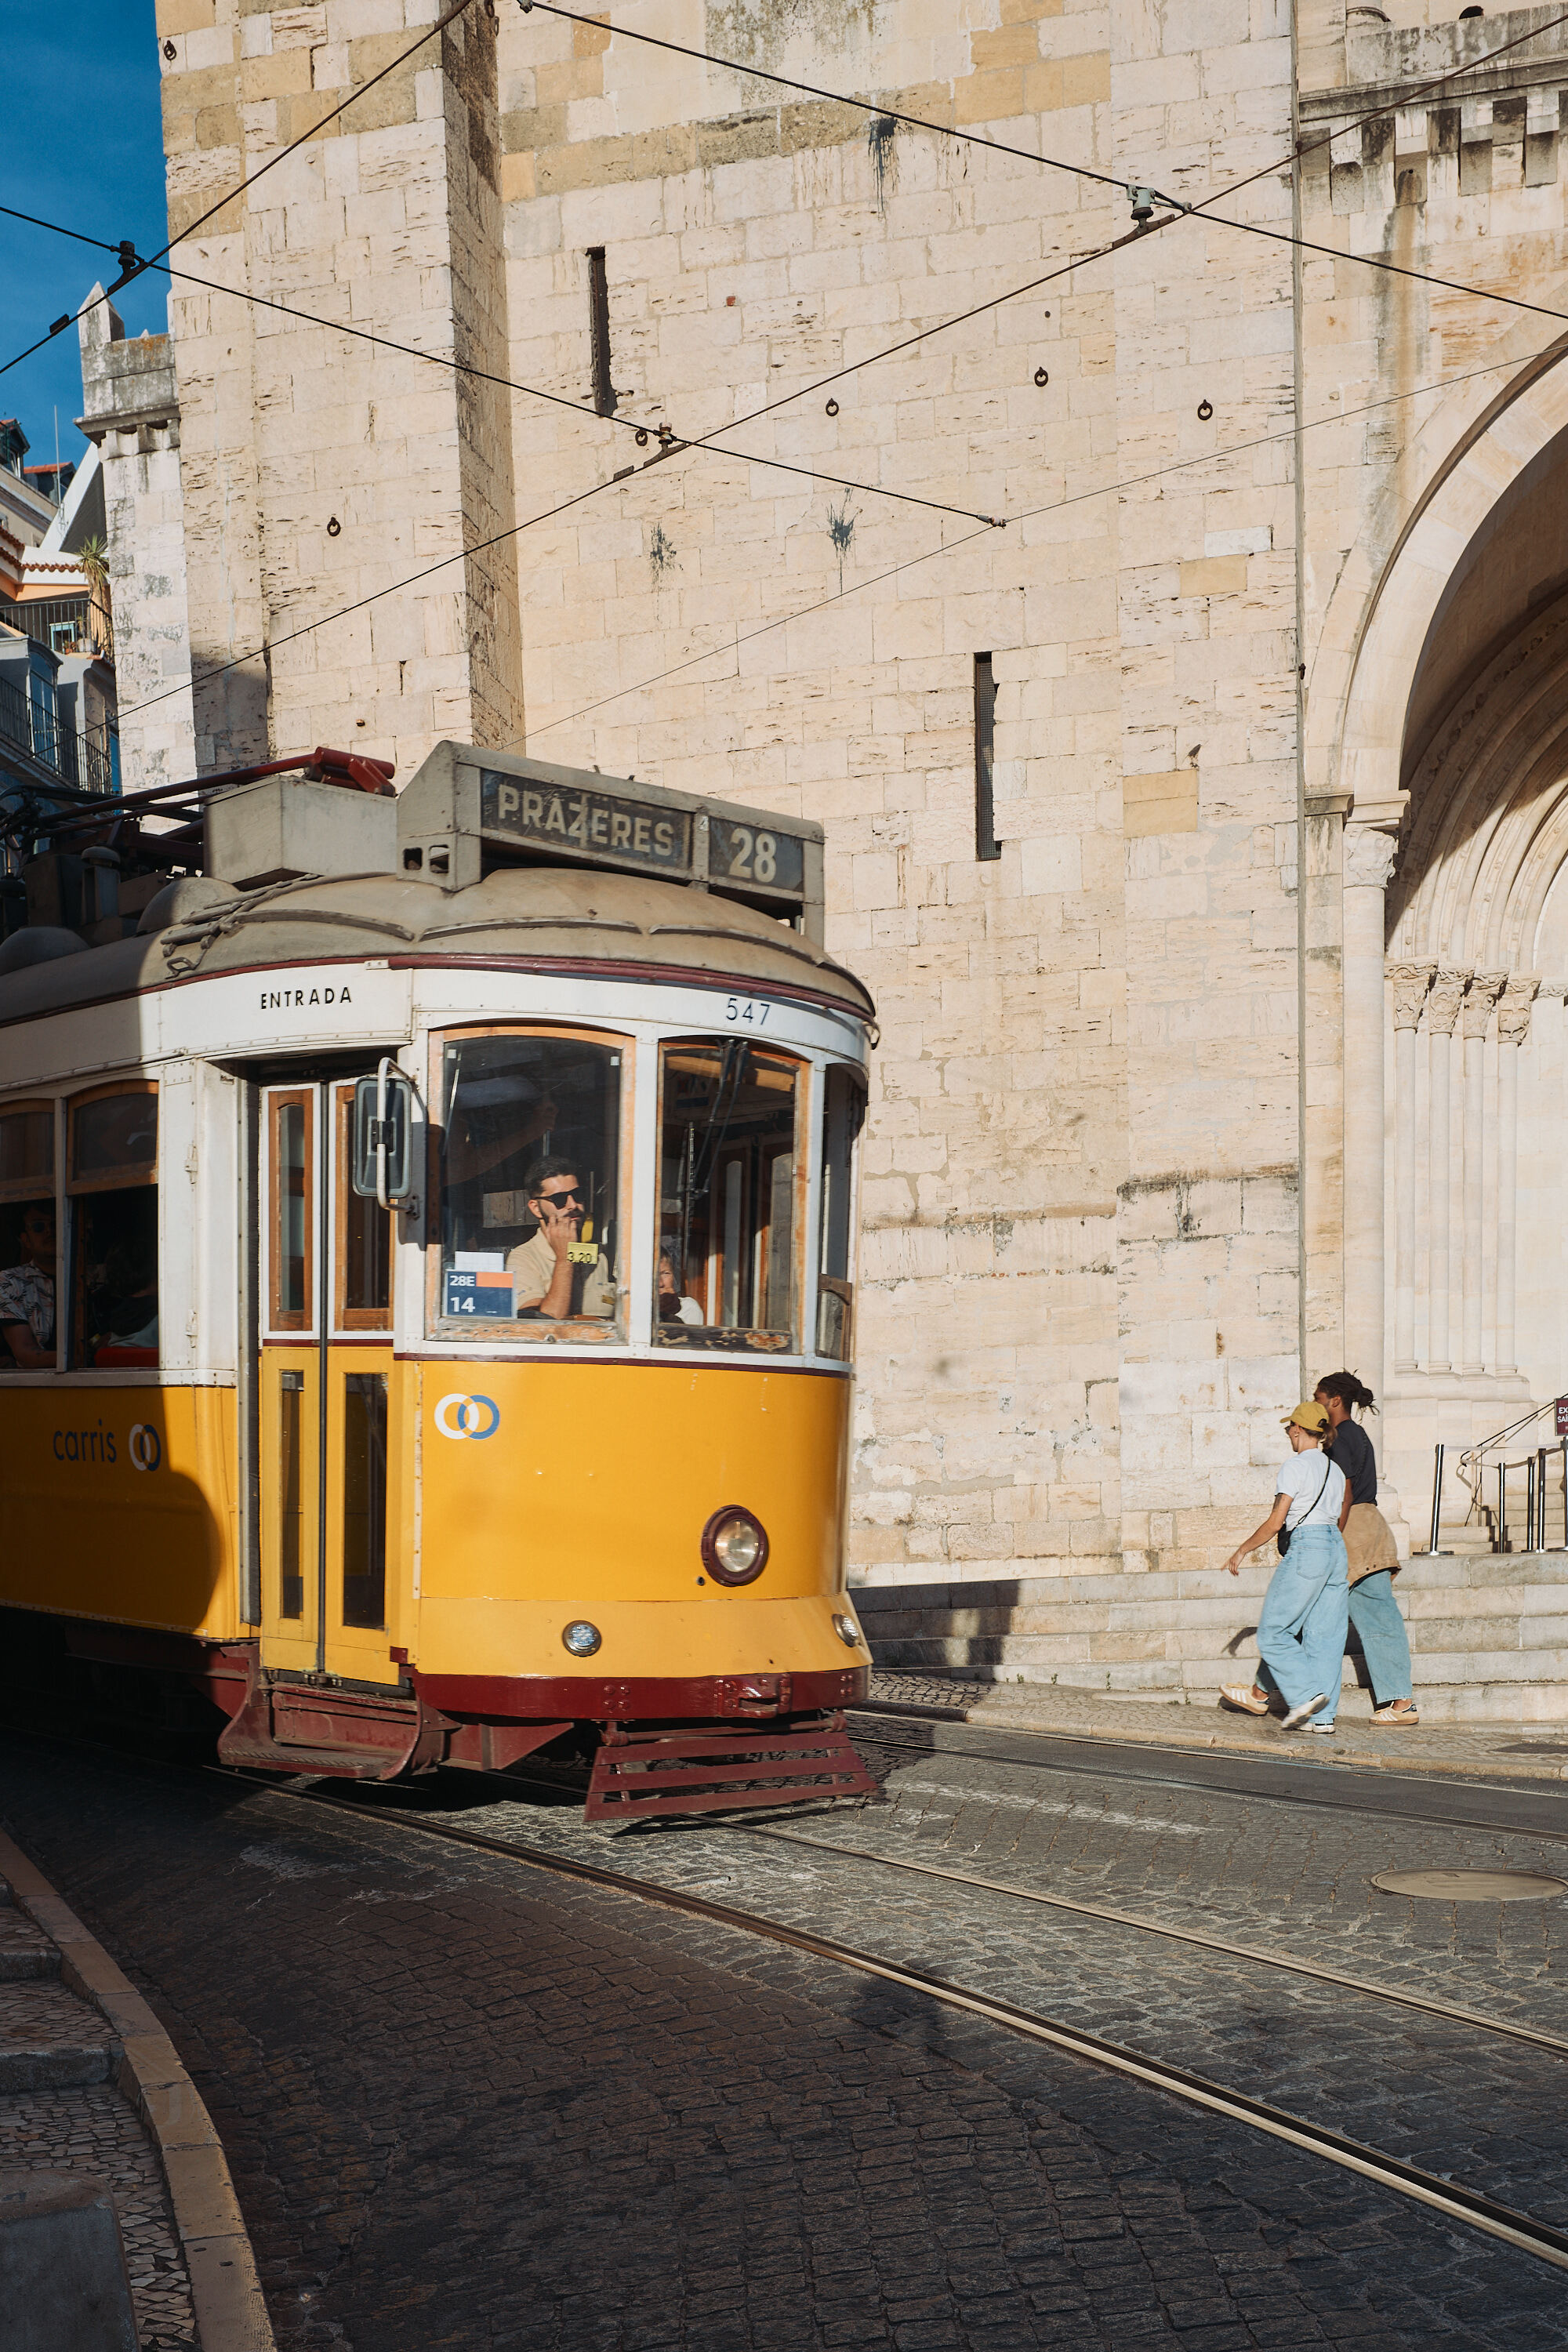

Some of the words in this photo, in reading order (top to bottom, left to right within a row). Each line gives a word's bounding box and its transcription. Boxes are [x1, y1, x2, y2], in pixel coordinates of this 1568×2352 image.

[499, 784, 674, 856] PRAZERES
[728, 828, 776, 883] 28
[261, 987, 351, 1009] ENTRADA
[726, 998, 770, 1025] 547
[449, 1276, 475, 1287] 28E
[450, 1297, 476, 1312] 14
[53, 1417, 117, 1464] carris
